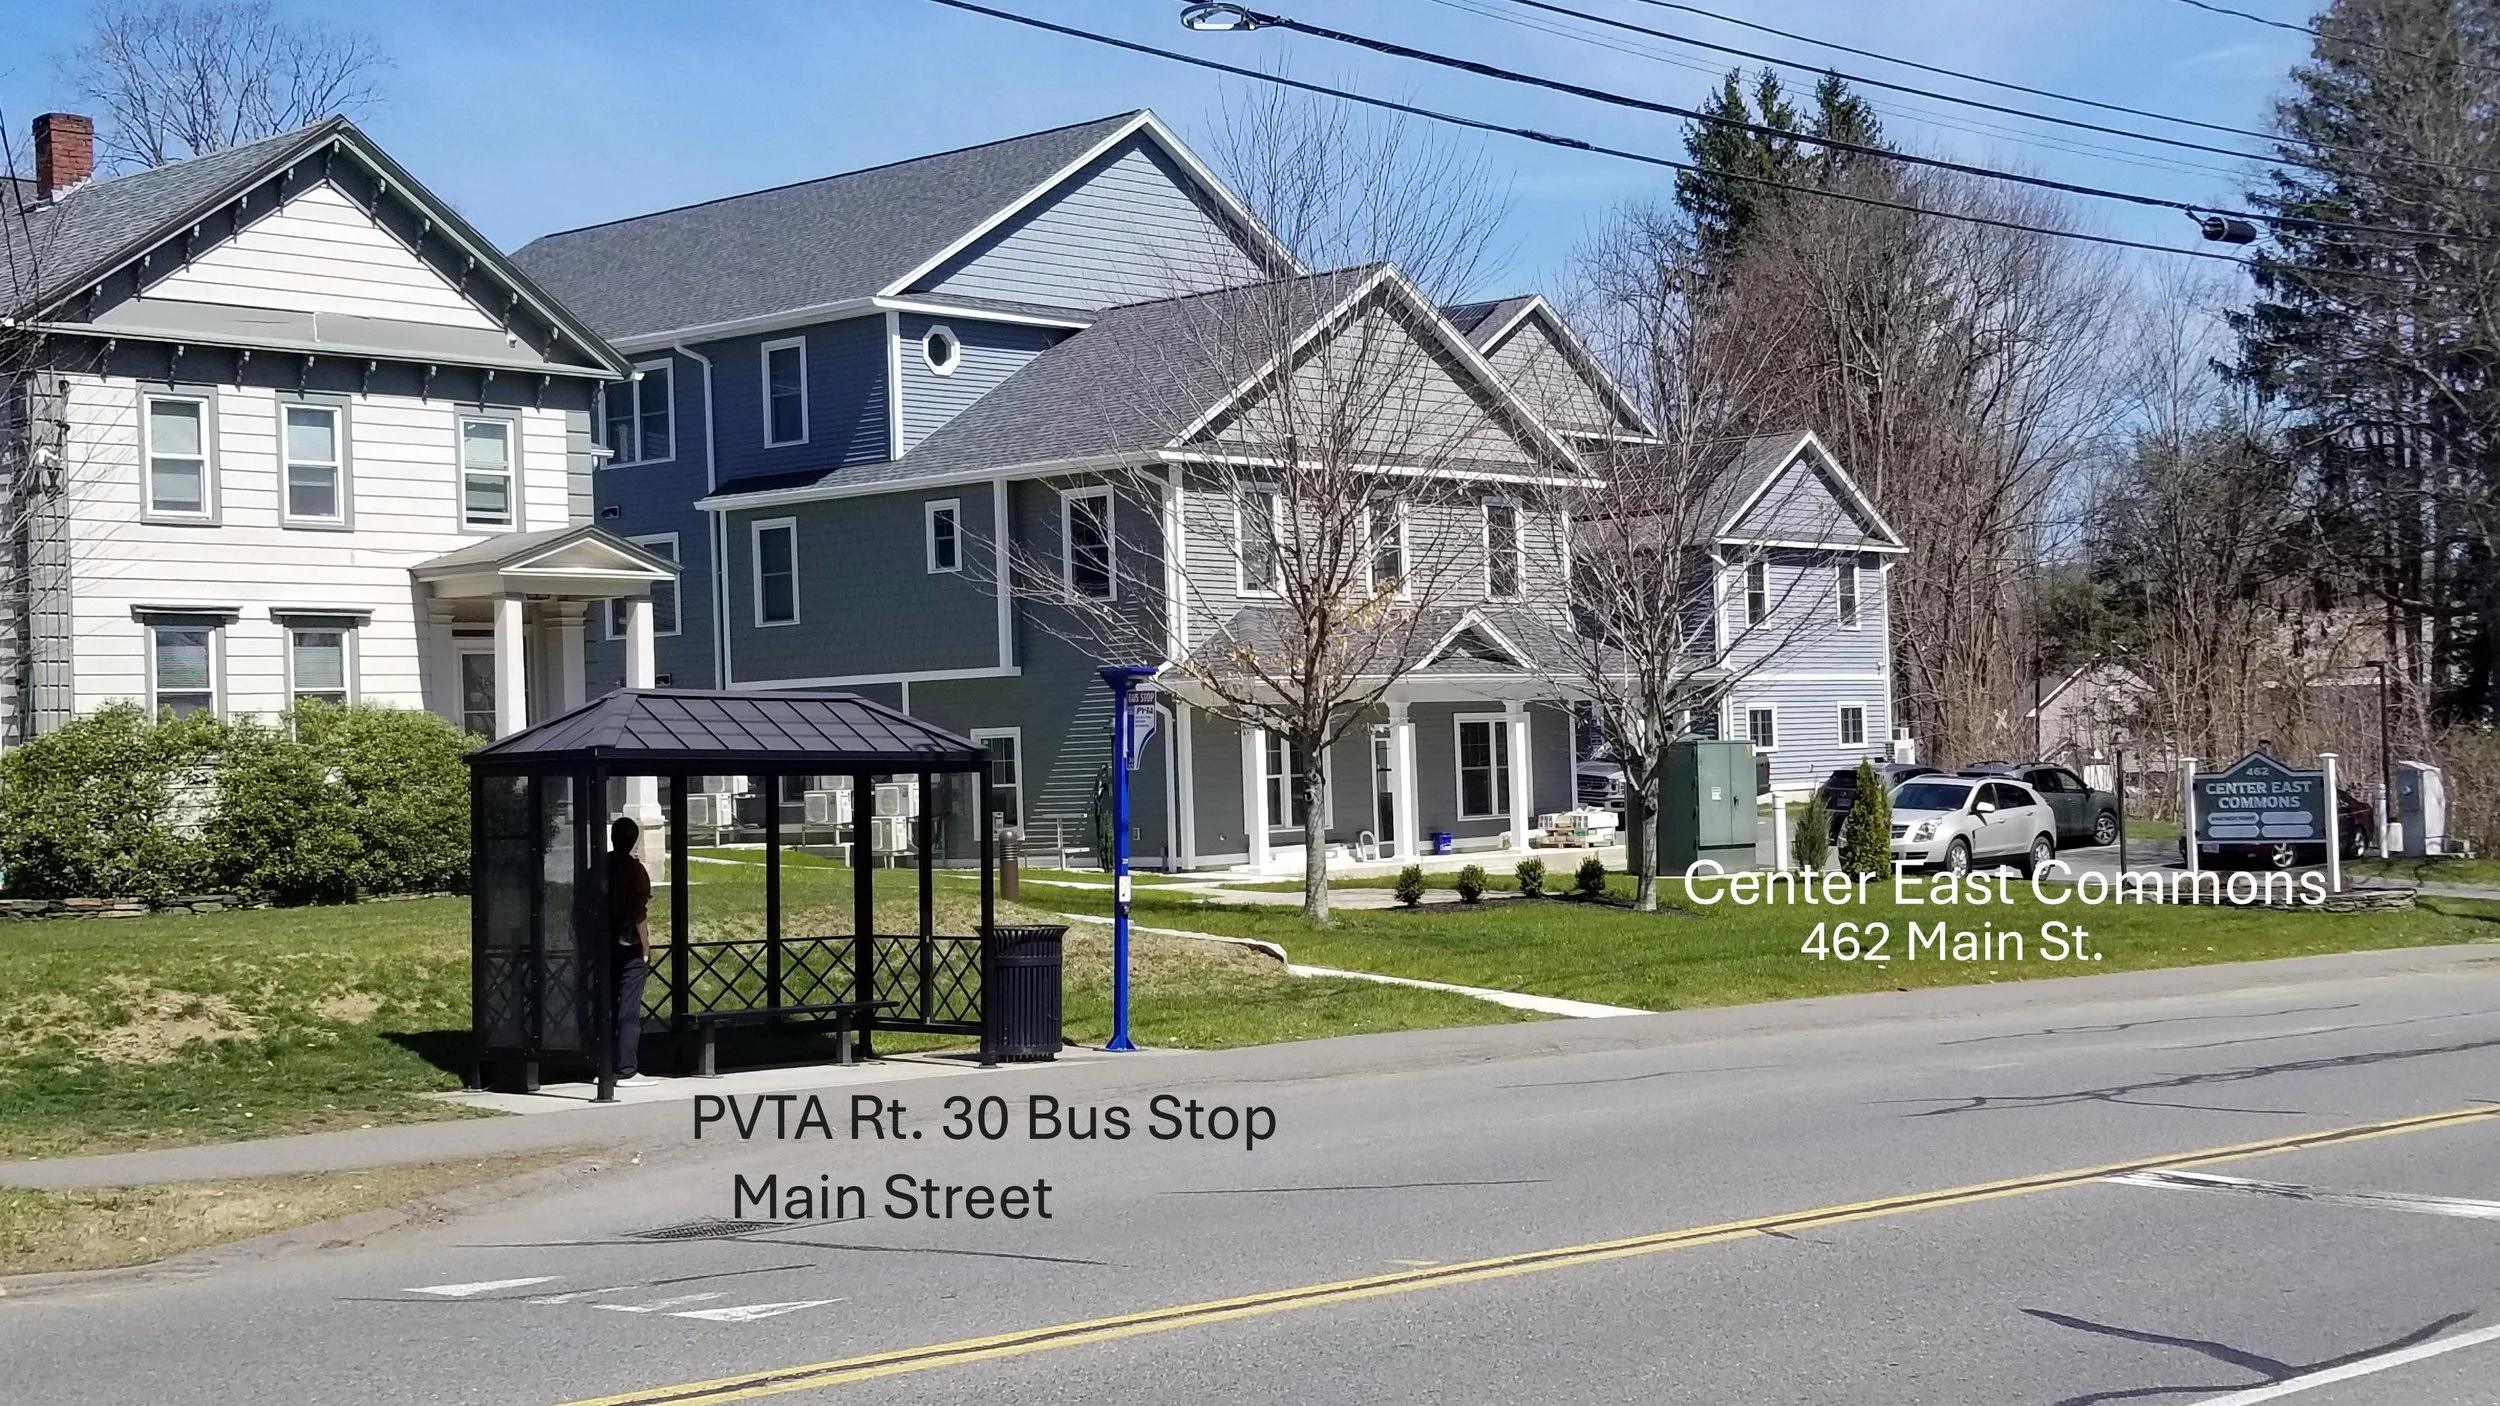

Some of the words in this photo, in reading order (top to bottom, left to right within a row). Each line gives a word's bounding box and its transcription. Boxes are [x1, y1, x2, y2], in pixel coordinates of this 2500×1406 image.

[1140, 692, 1154, 703] STOP
[2246, 767, 2269, 776] 462
[2205, 782, 2267, 794] CENTER
[2271, 780, 2312, 793] EAST
[2218, 796, 2301, 809] COMMONS
